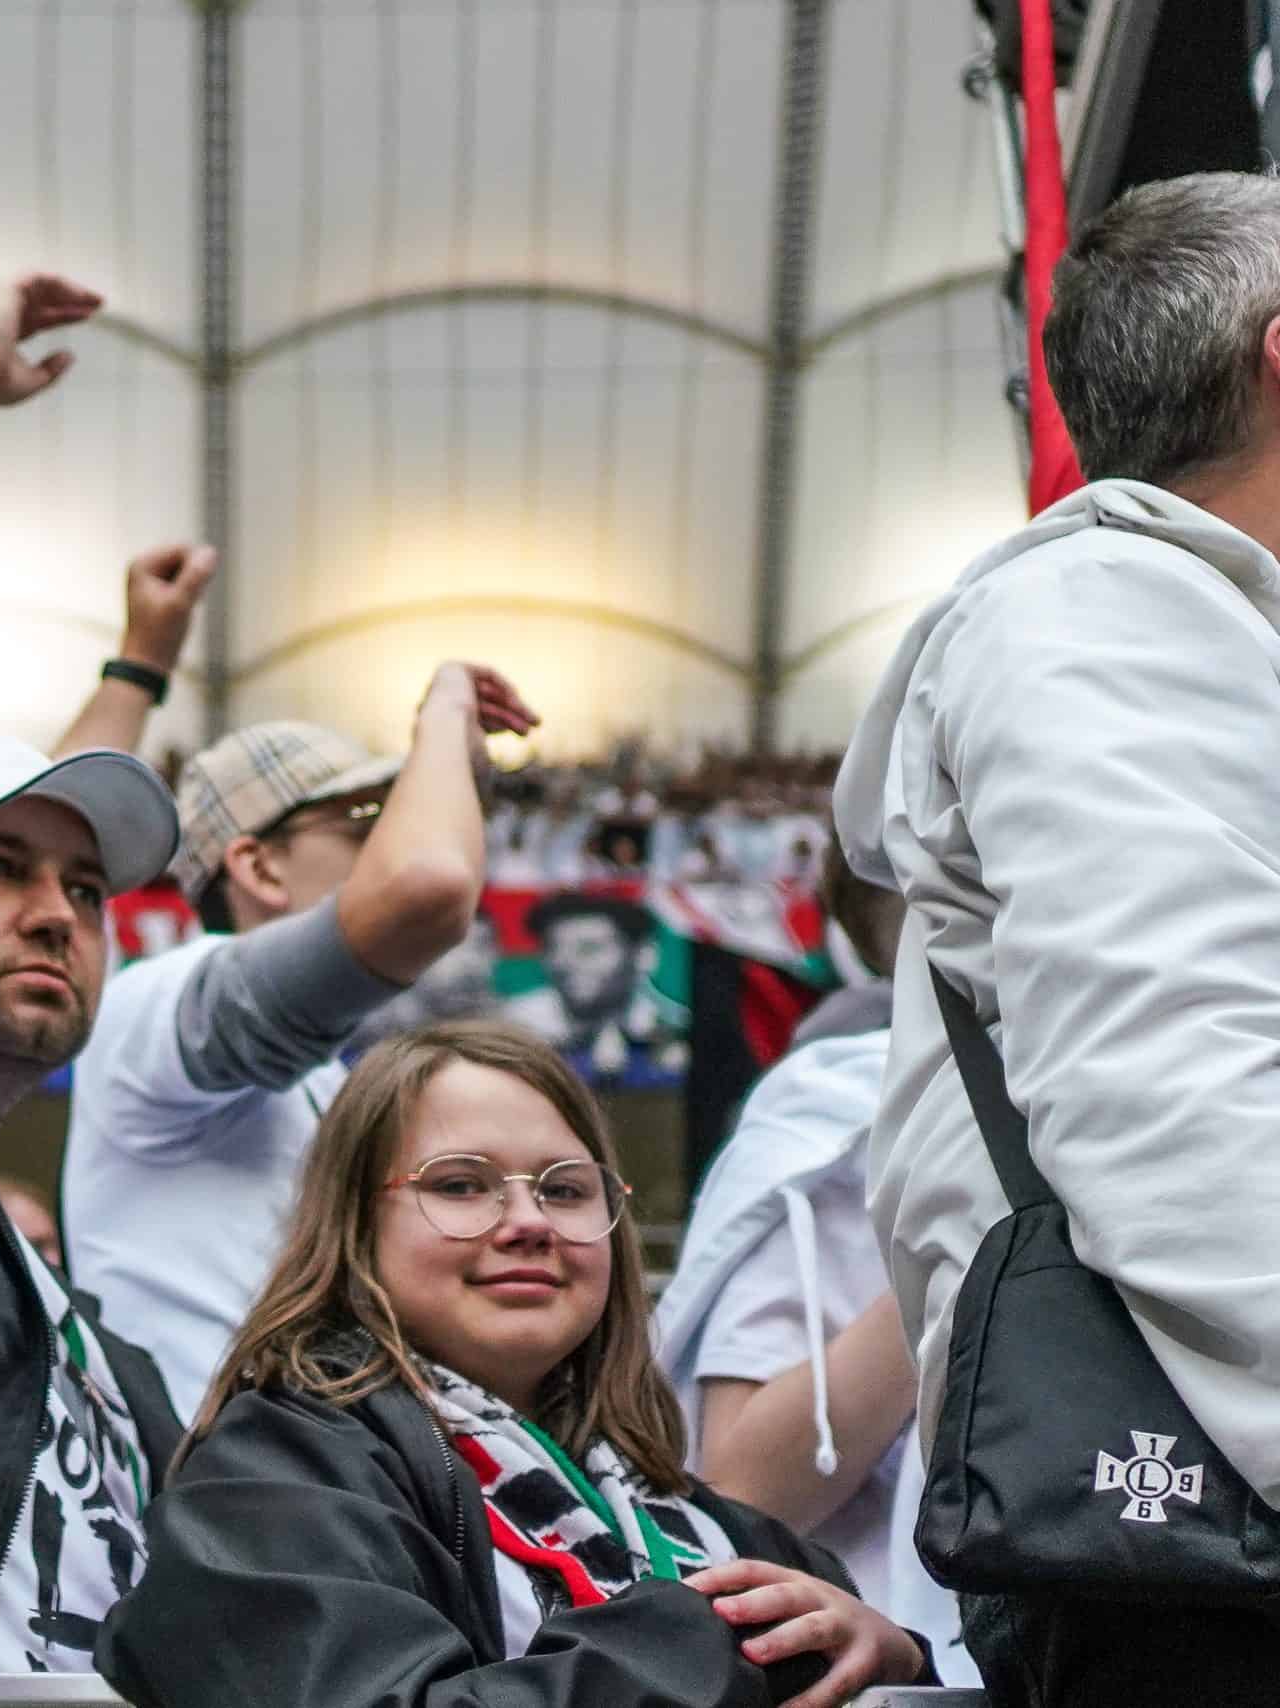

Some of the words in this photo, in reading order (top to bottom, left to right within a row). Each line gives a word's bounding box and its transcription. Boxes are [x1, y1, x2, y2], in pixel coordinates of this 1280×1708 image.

[1149, 1437, 1158, 1456] 1
[1107, 1463, 1115, 1483] 1
[1138, 1464, 1157, 1491] L
[1179, 1473, 1193, 1492] 9
[1137, 1501, 1151, 1518] 6
